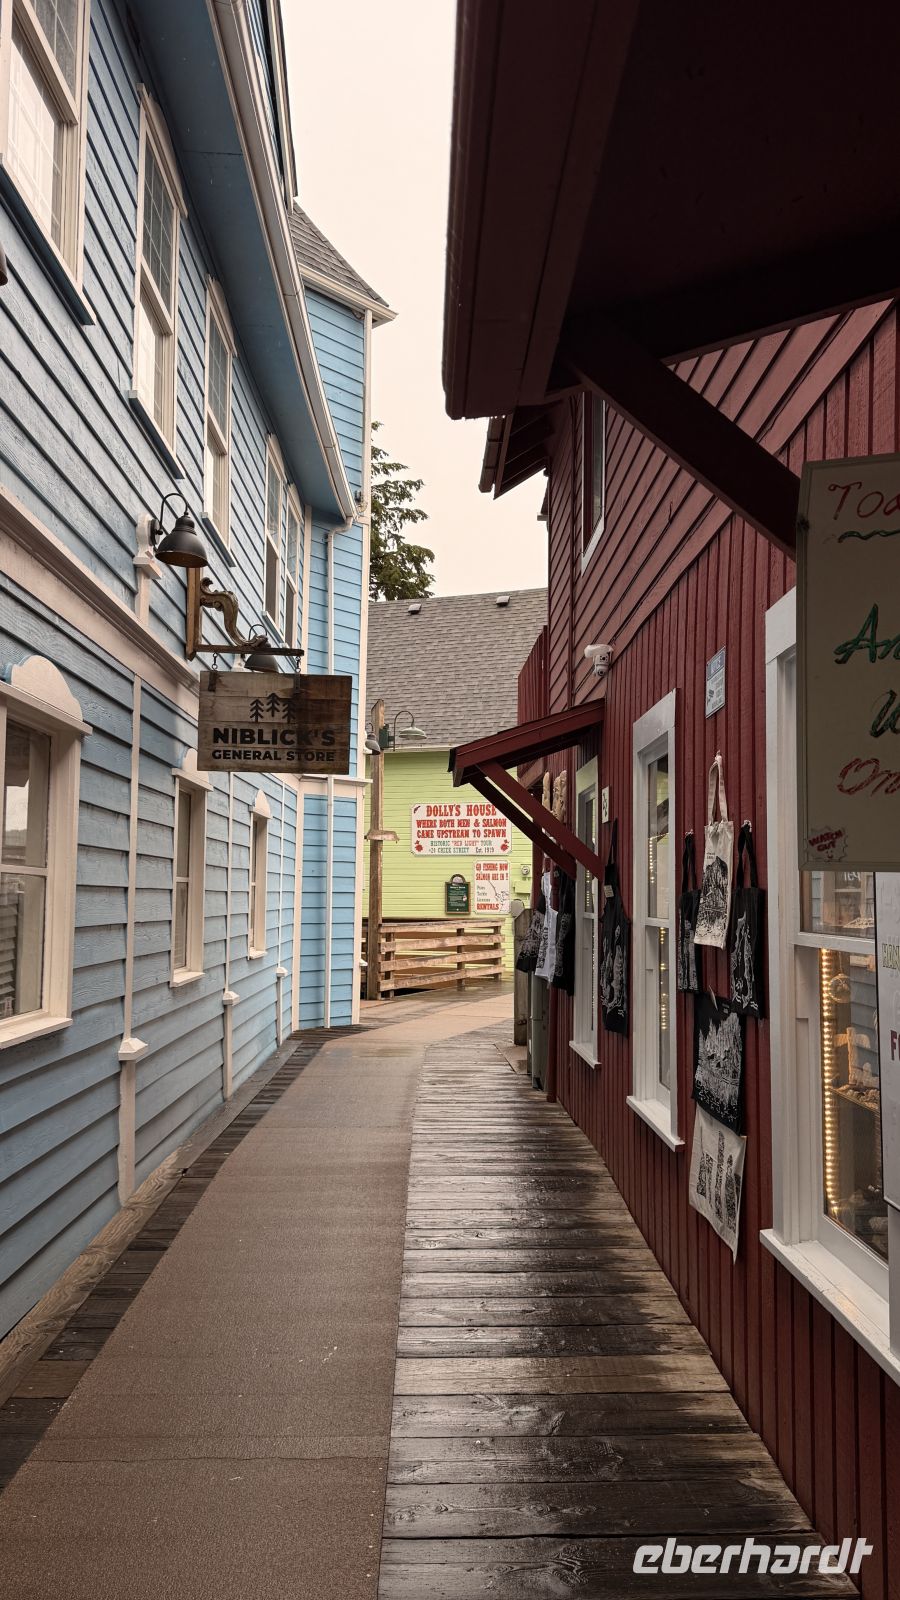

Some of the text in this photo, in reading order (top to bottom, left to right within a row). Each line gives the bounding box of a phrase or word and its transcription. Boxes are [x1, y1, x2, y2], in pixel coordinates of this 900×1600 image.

[213, 728, 335, 746] NIBLICK'S
[212, 750, 335, 761] GENERAL STORE
[426, 804, 497, 817] DOLLY'S HOUSE
[416, 818, 507, 828] WHERE BOTH MEN & SALMON
[416, 828, 507, 838] CAME UPSTREAM TO SPAWN
